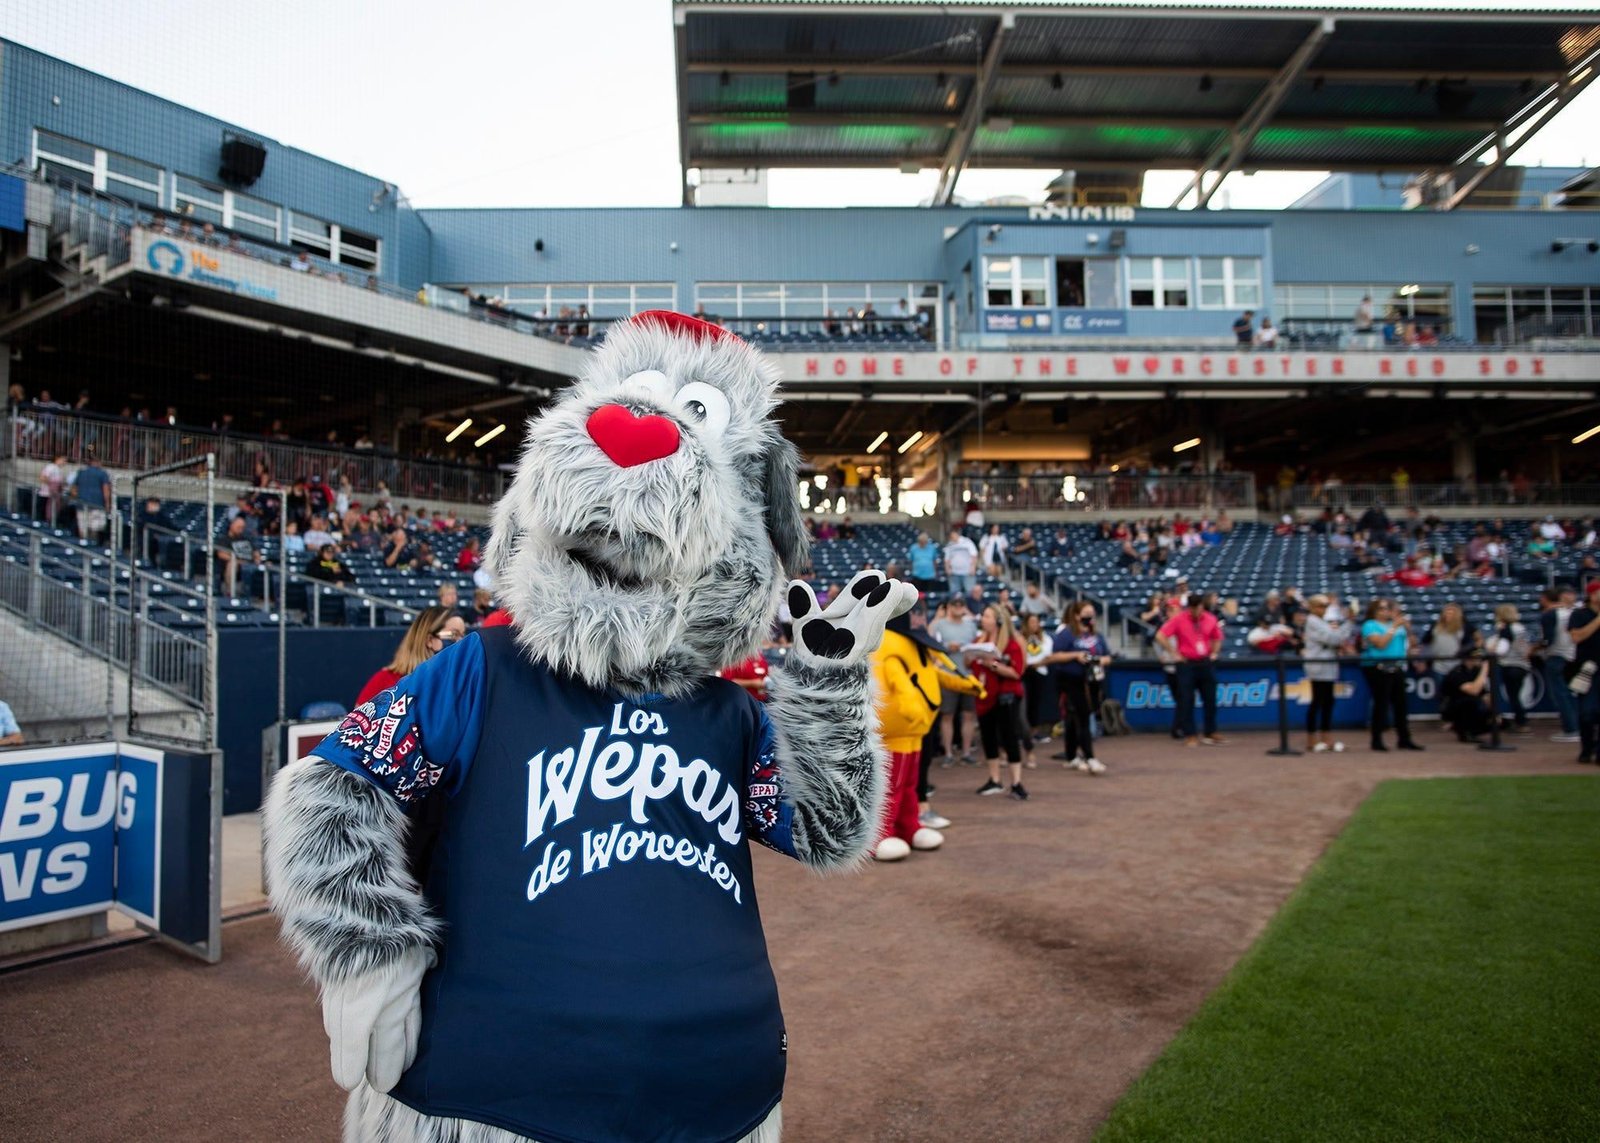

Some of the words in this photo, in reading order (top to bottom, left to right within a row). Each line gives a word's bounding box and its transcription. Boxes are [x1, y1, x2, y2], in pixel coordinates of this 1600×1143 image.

[806, 357, 904, 376] HOME
[939, 357, 978, 376] OF
[1012, 357, 1079, 376] THE
[1378, 357, 1445, 376] RED
[1478, 357, 1544, 376] SOX
[610, 702, 669, 736] Los
[0, 769, 138, 844] BUG
[524, 726, 742, 846] Wepas
[526, 841, 572, 901] de
[580, 822, 742, 904] Worcester
